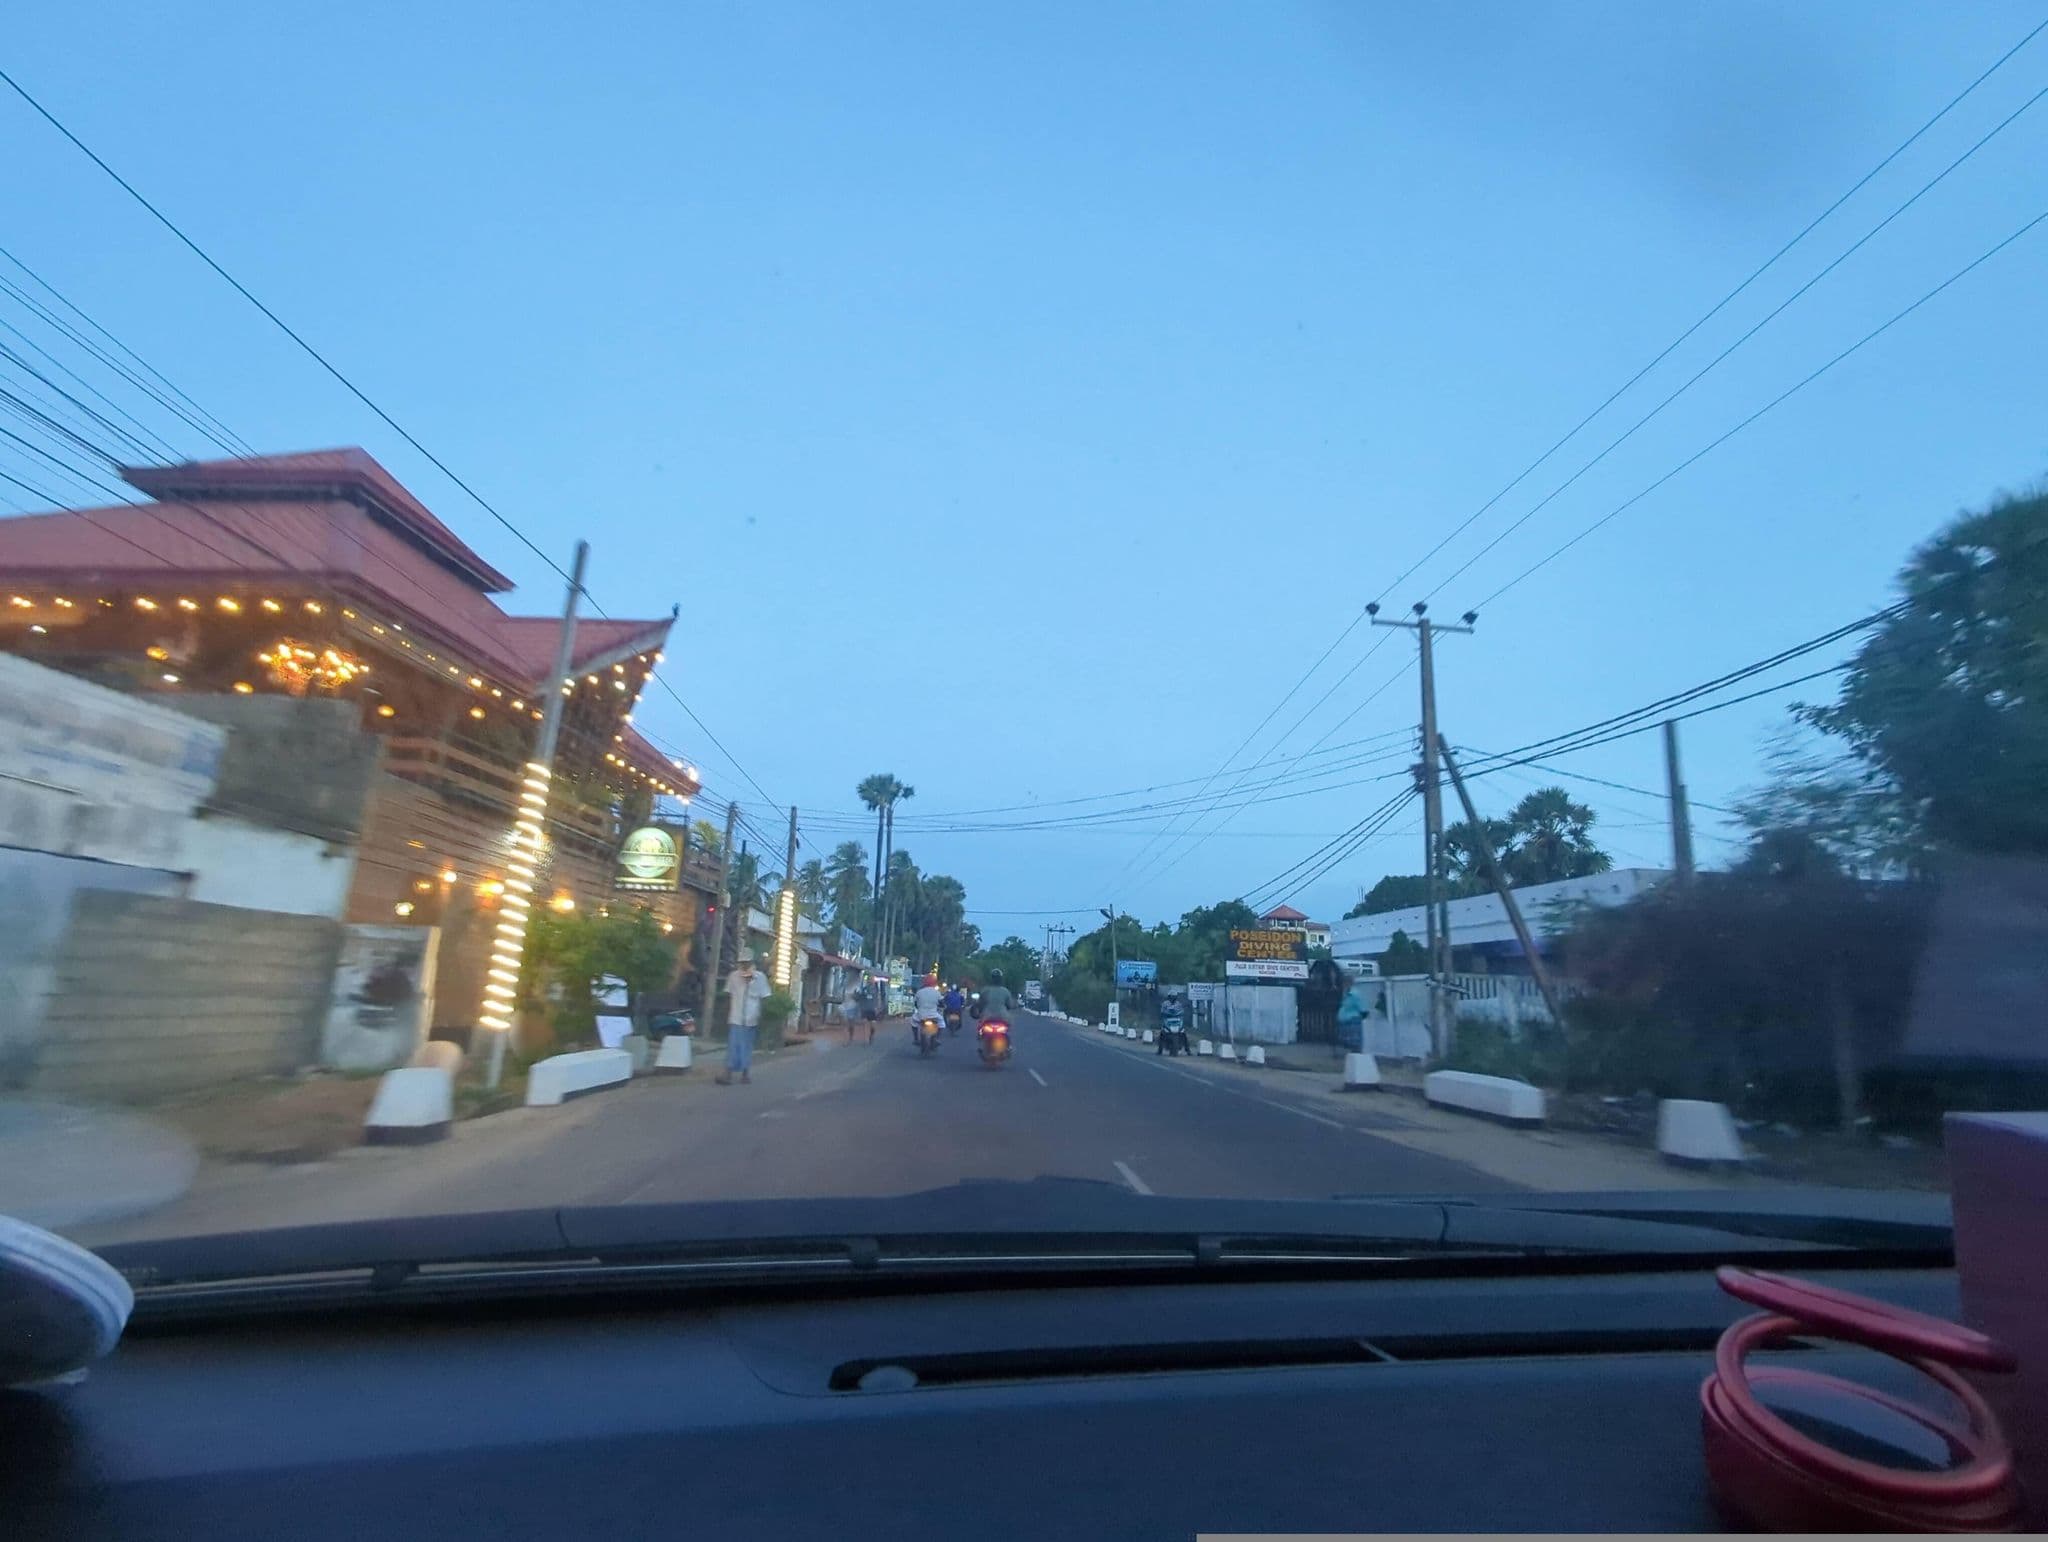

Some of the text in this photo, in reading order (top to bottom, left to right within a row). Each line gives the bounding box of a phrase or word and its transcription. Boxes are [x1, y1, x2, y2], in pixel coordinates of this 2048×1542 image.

[1230, 930, 1302, 943] POSEIDON
[1239, 941, 1291, 951] DIVING
[1237, 949, 1297, 959] CENTER
